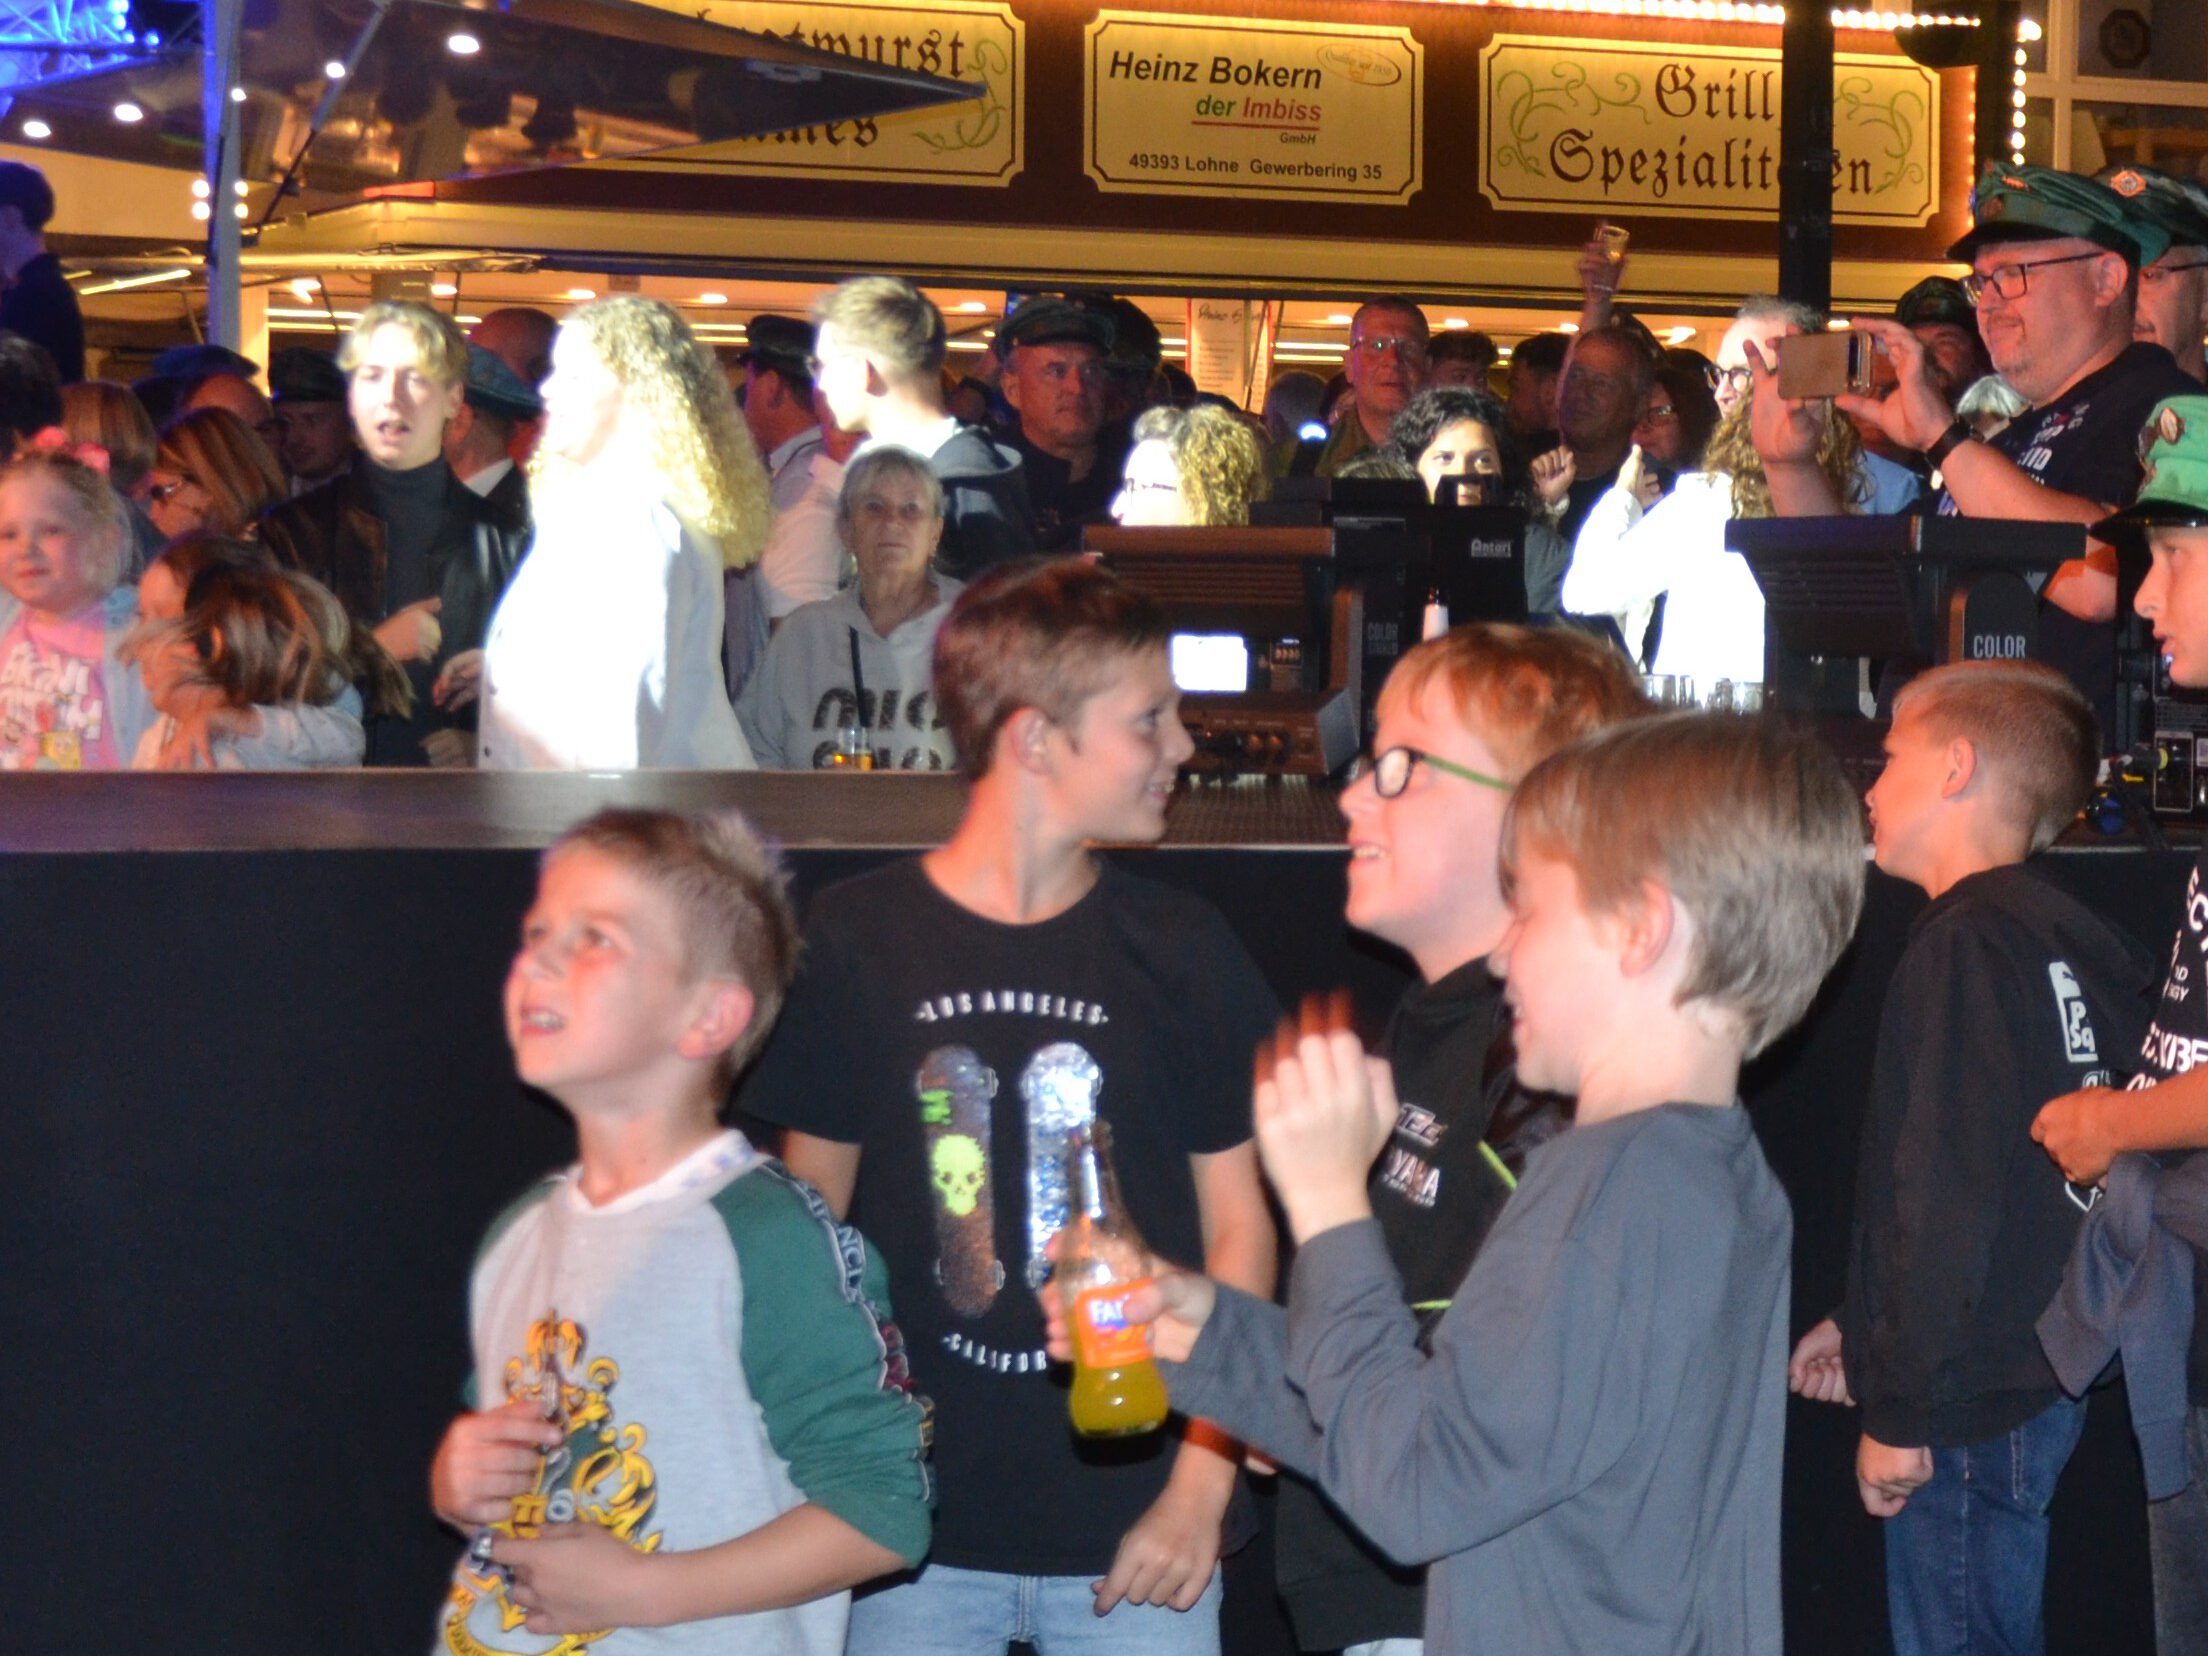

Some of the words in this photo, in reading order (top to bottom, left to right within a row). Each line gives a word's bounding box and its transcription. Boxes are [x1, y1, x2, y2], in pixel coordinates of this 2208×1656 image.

[1109, 51, 1198, 83] Heinz
[1209, 56, 1321, 89] Bokern
[1655, 63, 1775, 121] Grill
[1195, 95, 1235, 117] der
[1243, 98, 1321, 122] Imbiss
[1279, 132, 1316, 145] GmbH
[1129, 153, 1179, 170] 49393
[1185, 156, 1239, 173] Lohne
[1250, 159, 1357, 182] Gewerbering
[1363, 164, 1382, 179] 35
[1550, 128, 1873, 199] Spezialiten
[1973, 635, 2026, 659] COLOR
[924, 992, 974, 1022] LOS
[984, 990, 1103, 1026] ANGELES
